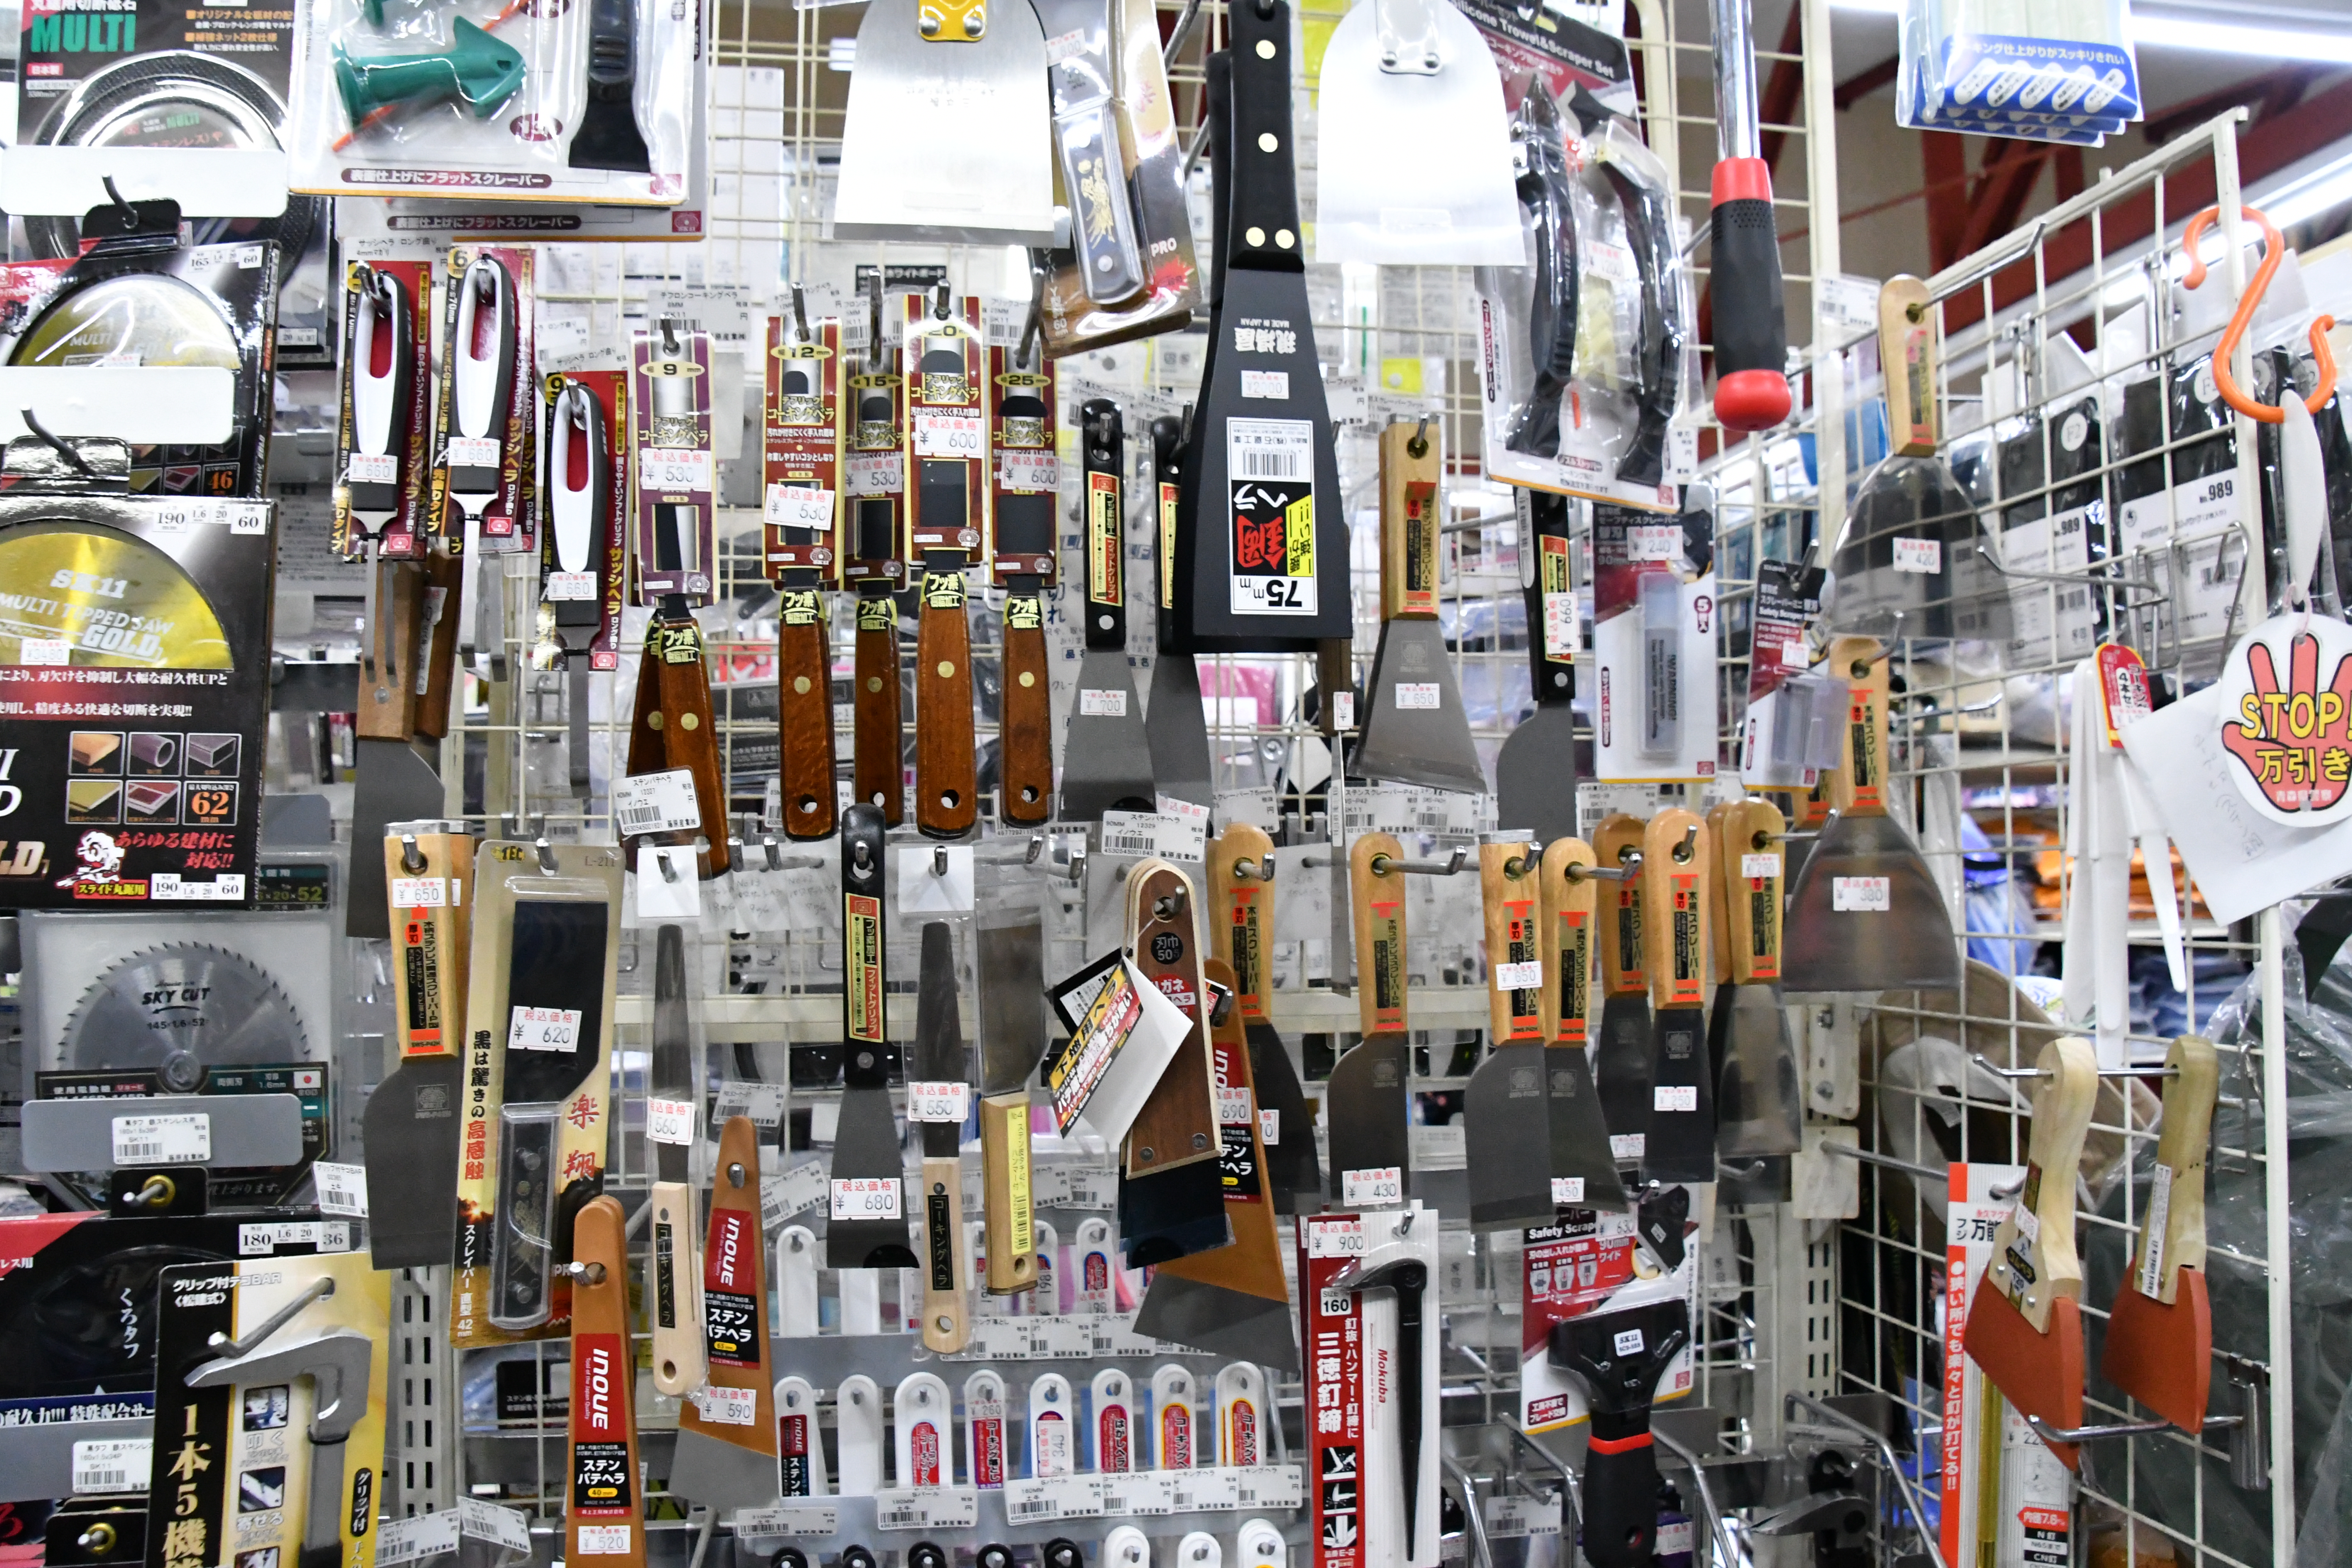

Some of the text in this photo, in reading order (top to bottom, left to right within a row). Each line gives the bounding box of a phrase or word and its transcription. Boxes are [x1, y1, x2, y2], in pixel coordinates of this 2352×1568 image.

[30, 14, 136, 52] MULTI
[1951, 43, 2125, 64] キング仕上がりがスッキリきれい
[1594, 59, 1614, 79] Set
[1151, 237, 1177, 257] PRO
[244, 255, 258, 263] 60
[1241, 318, 1289, 328] MADE IN JAPAN
[790, 347, 814, 358] 12
[663, 364, 677, 375] 9
[863, 376, 887, 386] 15
[1008, 375, 1034, 385] 25
[928, 420, 976, 430] 税込価格
[949, 433, 977, 449] 600
[468, 448, 493, 461] 660
[653, 452, 702, 463] 税込価格
[1012, 456, 1055, 466] 税込価格
[367, 465, 390, 478] 660
[851, 460, 894, 470] 税込価格
[871, 471, 896, 486] 530
[1031, 469, 1056, 484] 600
[779, 489, 826, 502] 税込価格
[1233, 483, 1288, 510] ヘラ
[2208, 479, 2233, 501] 989
[157, 510, 258, 528] 190 1.6 20 60
[799, 504, 826, 521] 530
[1236, 515, 1287, 569] 鋼
[50, 569, 128, 599] SK11
[567, 581, 590, 595] 660
[607, 547, 623, 615] サッシヘラ
[930, 574, 959, 590] フッ素
[785, 593, 814, 608] フッ素
[1266, 580, 1302, 607] 75
[861, 600, 886, 615] フッ素
[1012, 599, 1037, 613] フッ素
[62, 603, 129, 628] TIPPED
[82, 625, 161, 658] GOLD
[663, 629, 695, 646] フッ素
[1413, 692, 1435, 705] 650
[1100, 700, 1121, 712] 700
[2256, 747, 2350, 784] 万引き
[633, 775, 672, 787] ステンパテヘラ
[192, 792, 229, 815] 62
[1131, 814, 1180, 823] ステンパテヘラ
[585, 855, 615, 867] L-211
[155, 882, 178, 893] 190
[221, 885, 238, 895] 60
[415, 889, 439, 901] 650
[1859, 889, 1884, 902] 380
[1515, 971, 1536, 983] 650
[142, 987, 211, 1005] SKY CUT
[868, 969, 877, 1034] フィットグリップ
[524, 1010, 572, 1023] 税込価格
[543, 1026, 570, 1044] 620
[915, 1085, 961, 1097] 税込価格
[926, 1100, 953, 1116] 550
[1222, 1104, 1247, 1119] 690
[655, 1117, 678, 1135] 560
[1352, 1170, 1393, 1181] 税込価格
[842, 1181, 892, 1192] 税込価格
[1373, 1184, 1396, 1198] 430
[864, 1194, 894, 1211] 680
[1319, 1222, 1361, 1233] 税込価格
[1529, 1226, 1563, 1239] Safety
[243, 1228, 343, 1247] 180 1.6 20 36
[1339, 1236, 1364, 1250] 900
[720, 1217, 740, 1287] INOUE
[458, 1225, 476, 1330] スクレイパー 42
[1323, 1299, 1349, 1313] 160
[120, 1288, 139, 1359] くろタフ
[709, 1309, 749, 1325] ステン
[1316, 1332, 1342, 1434] 三徳釘締
[1377, 1349, 1387, 1404] Mokuba
[592, 1348, 608, 1430] INOUE
[710, 1389, 749, 1400] 税込価格
[728, 1404, 750, 1418] 590
[982, 1405, 1001, 1416] 260
[583, 1460, 620, 1472] ステン
[577, 1473, 626, 1485] パテヘラ
[352, 1470, 371, 1533] グリップ付
[598, 1536, 623, 1549] 520
